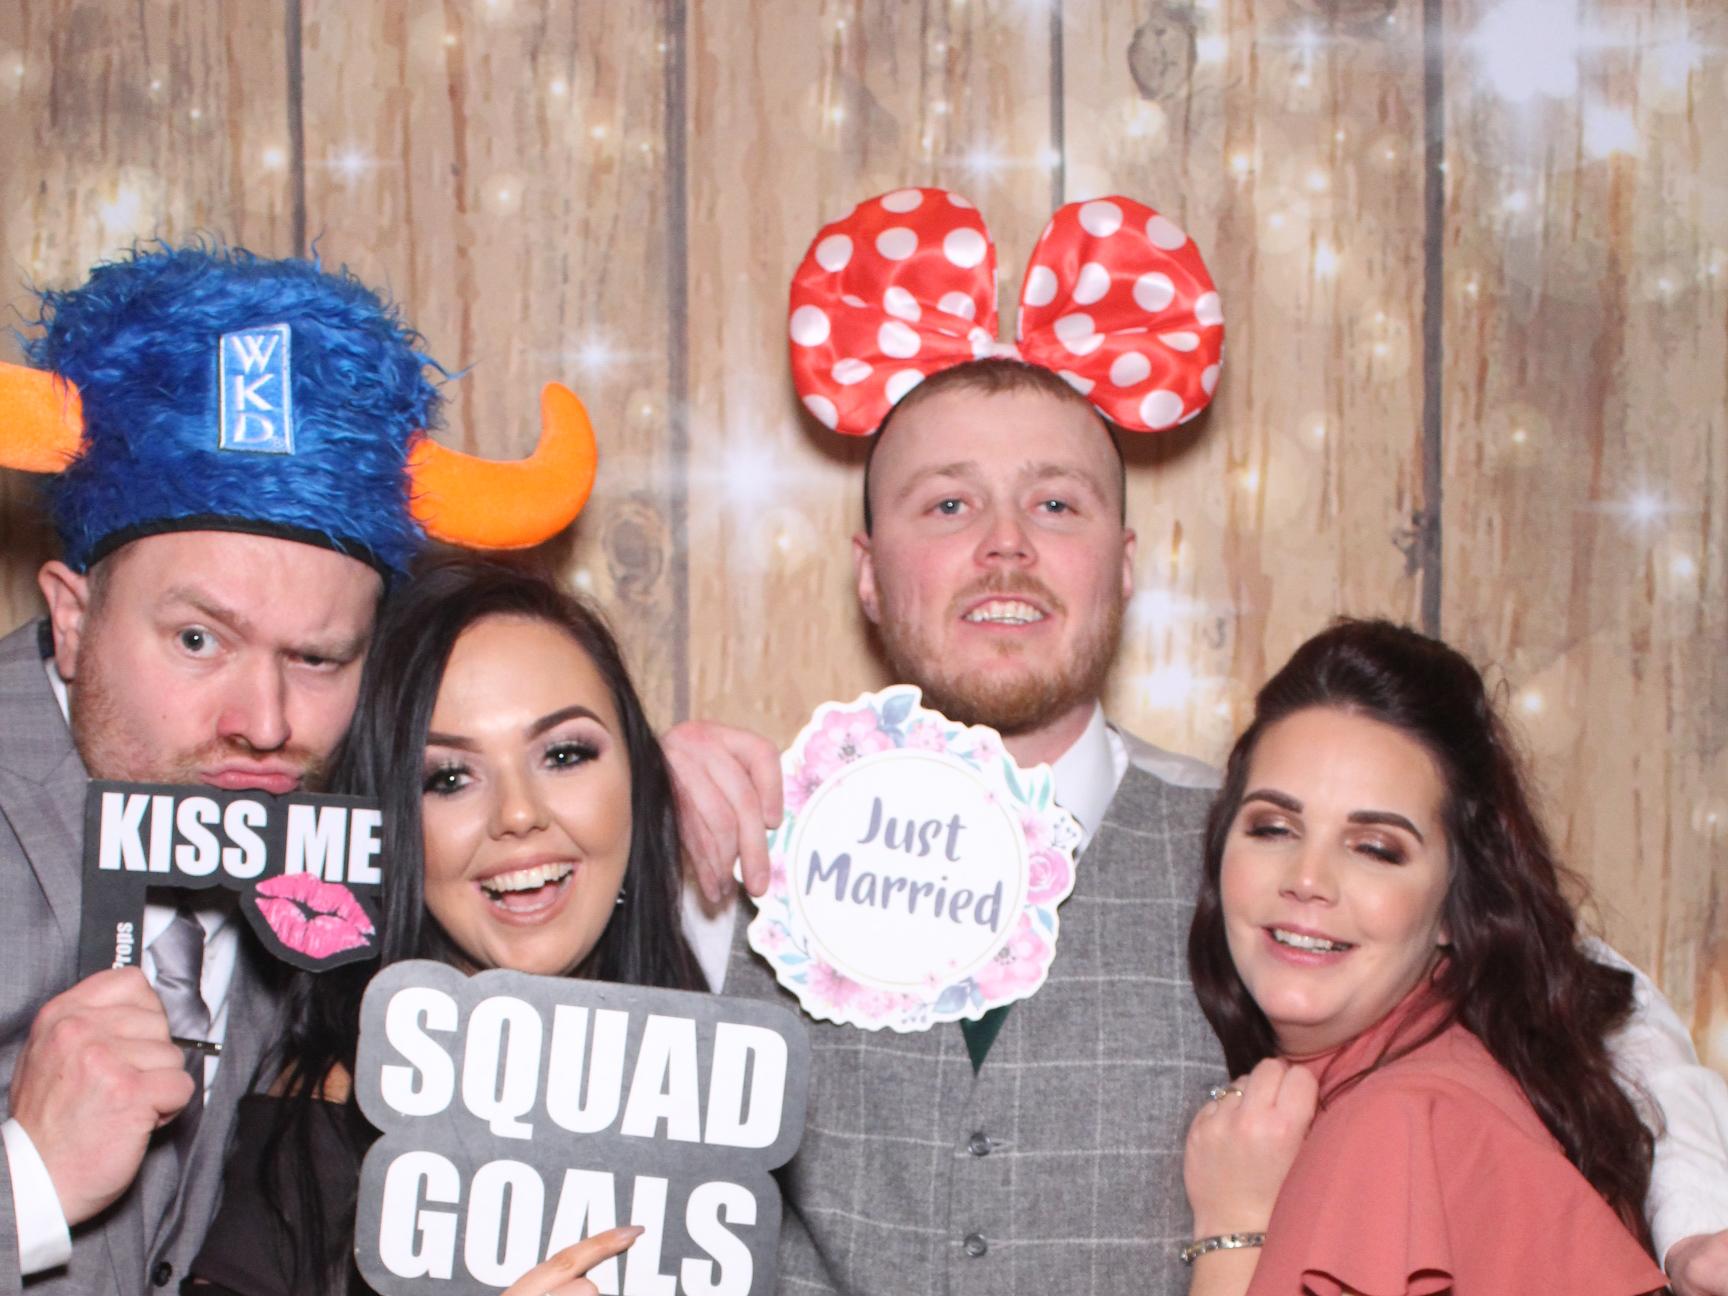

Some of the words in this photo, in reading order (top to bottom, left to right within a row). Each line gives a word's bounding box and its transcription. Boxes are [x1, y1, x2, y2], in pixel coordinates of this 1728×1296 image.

[230, 334, 279, 443] WKD
[99, 792, 268, 879] KISS
[284, 803, 383, 885] ME
[857, 796, 967, 862] Just
[804, 850, 1003, 934] Married
[380, 986, 788, 1149] SQUAD
